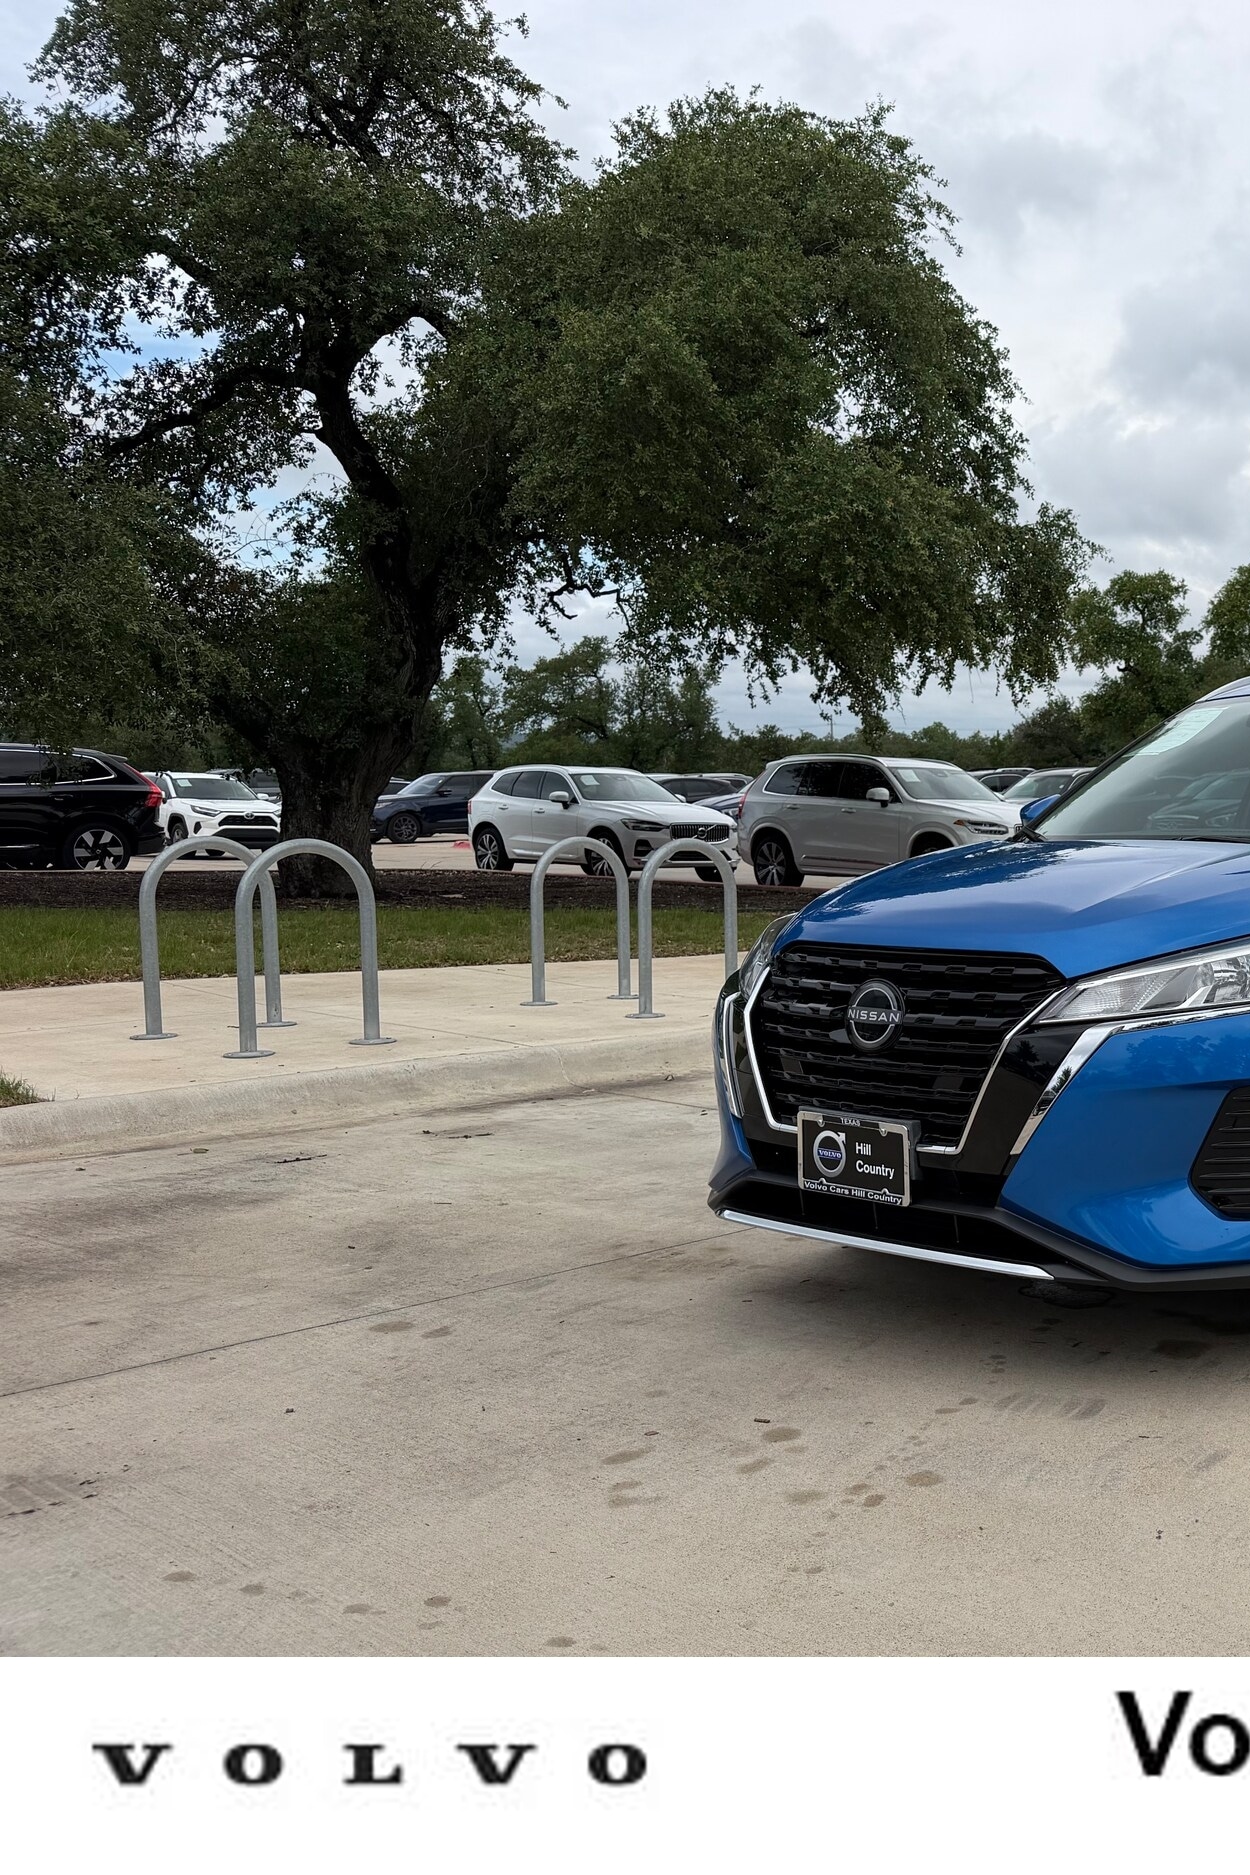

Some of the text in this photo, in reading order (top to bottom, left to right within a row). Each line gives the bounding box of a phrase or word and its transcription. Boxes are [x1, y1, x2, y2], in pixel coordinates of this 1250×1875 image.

[848, 1008, 900, 1022] NISSAN
[840, 1118, 861, 1127] TEXAS
[819, 1150, 842, 1159] VOLVO
[855, 1142, 872, 1156] Hill
[855, 1160, 895, 1179] Country
[804, 1181, 902, 1205] Volvo Cars Hill Country
